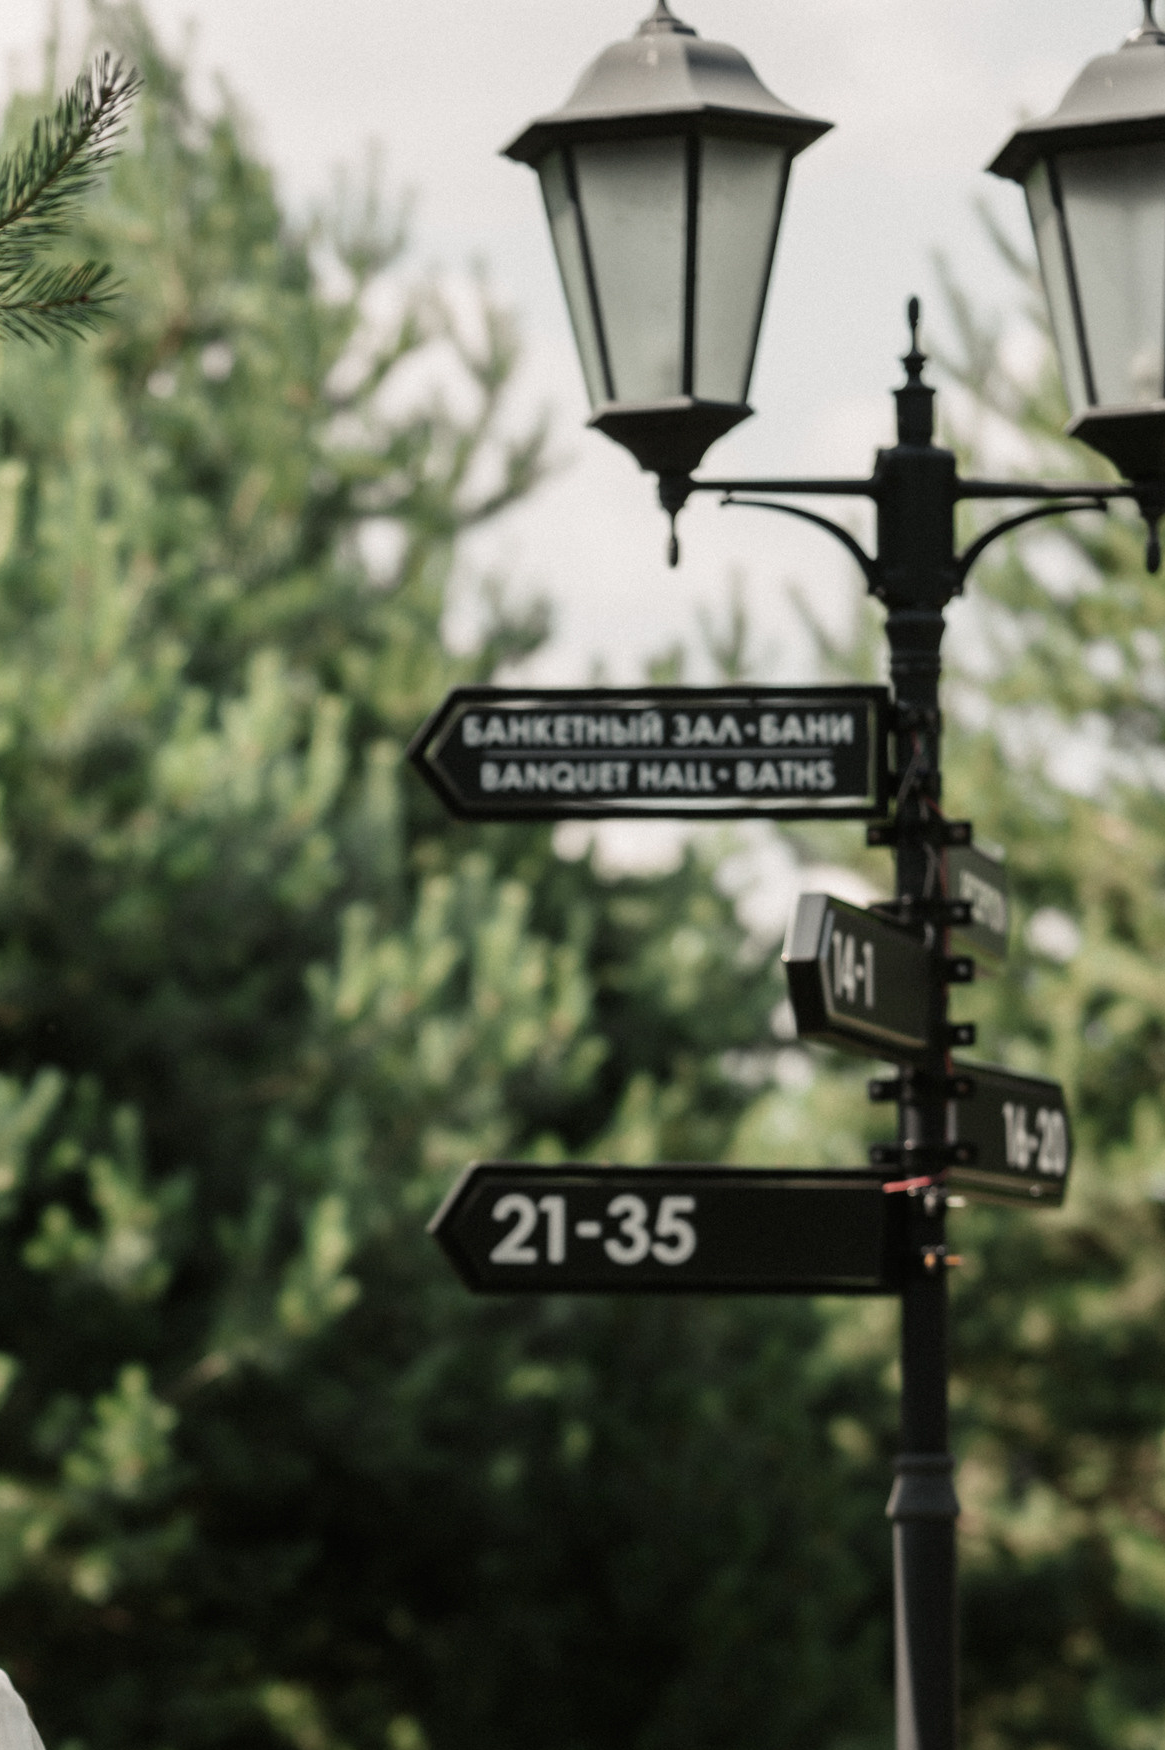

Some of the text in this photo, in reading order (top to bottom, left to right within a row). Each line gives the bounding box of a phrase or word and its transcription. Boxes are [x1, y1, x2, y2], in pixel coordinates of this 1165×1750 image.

[462, 711, 855, 747] БАНКЕТНЫЙ ЗАЛ БАНИ
[480, 760, 835, 793] BANQUET HALL BATHS
[489, 1194, 698, 1266] 21-35
